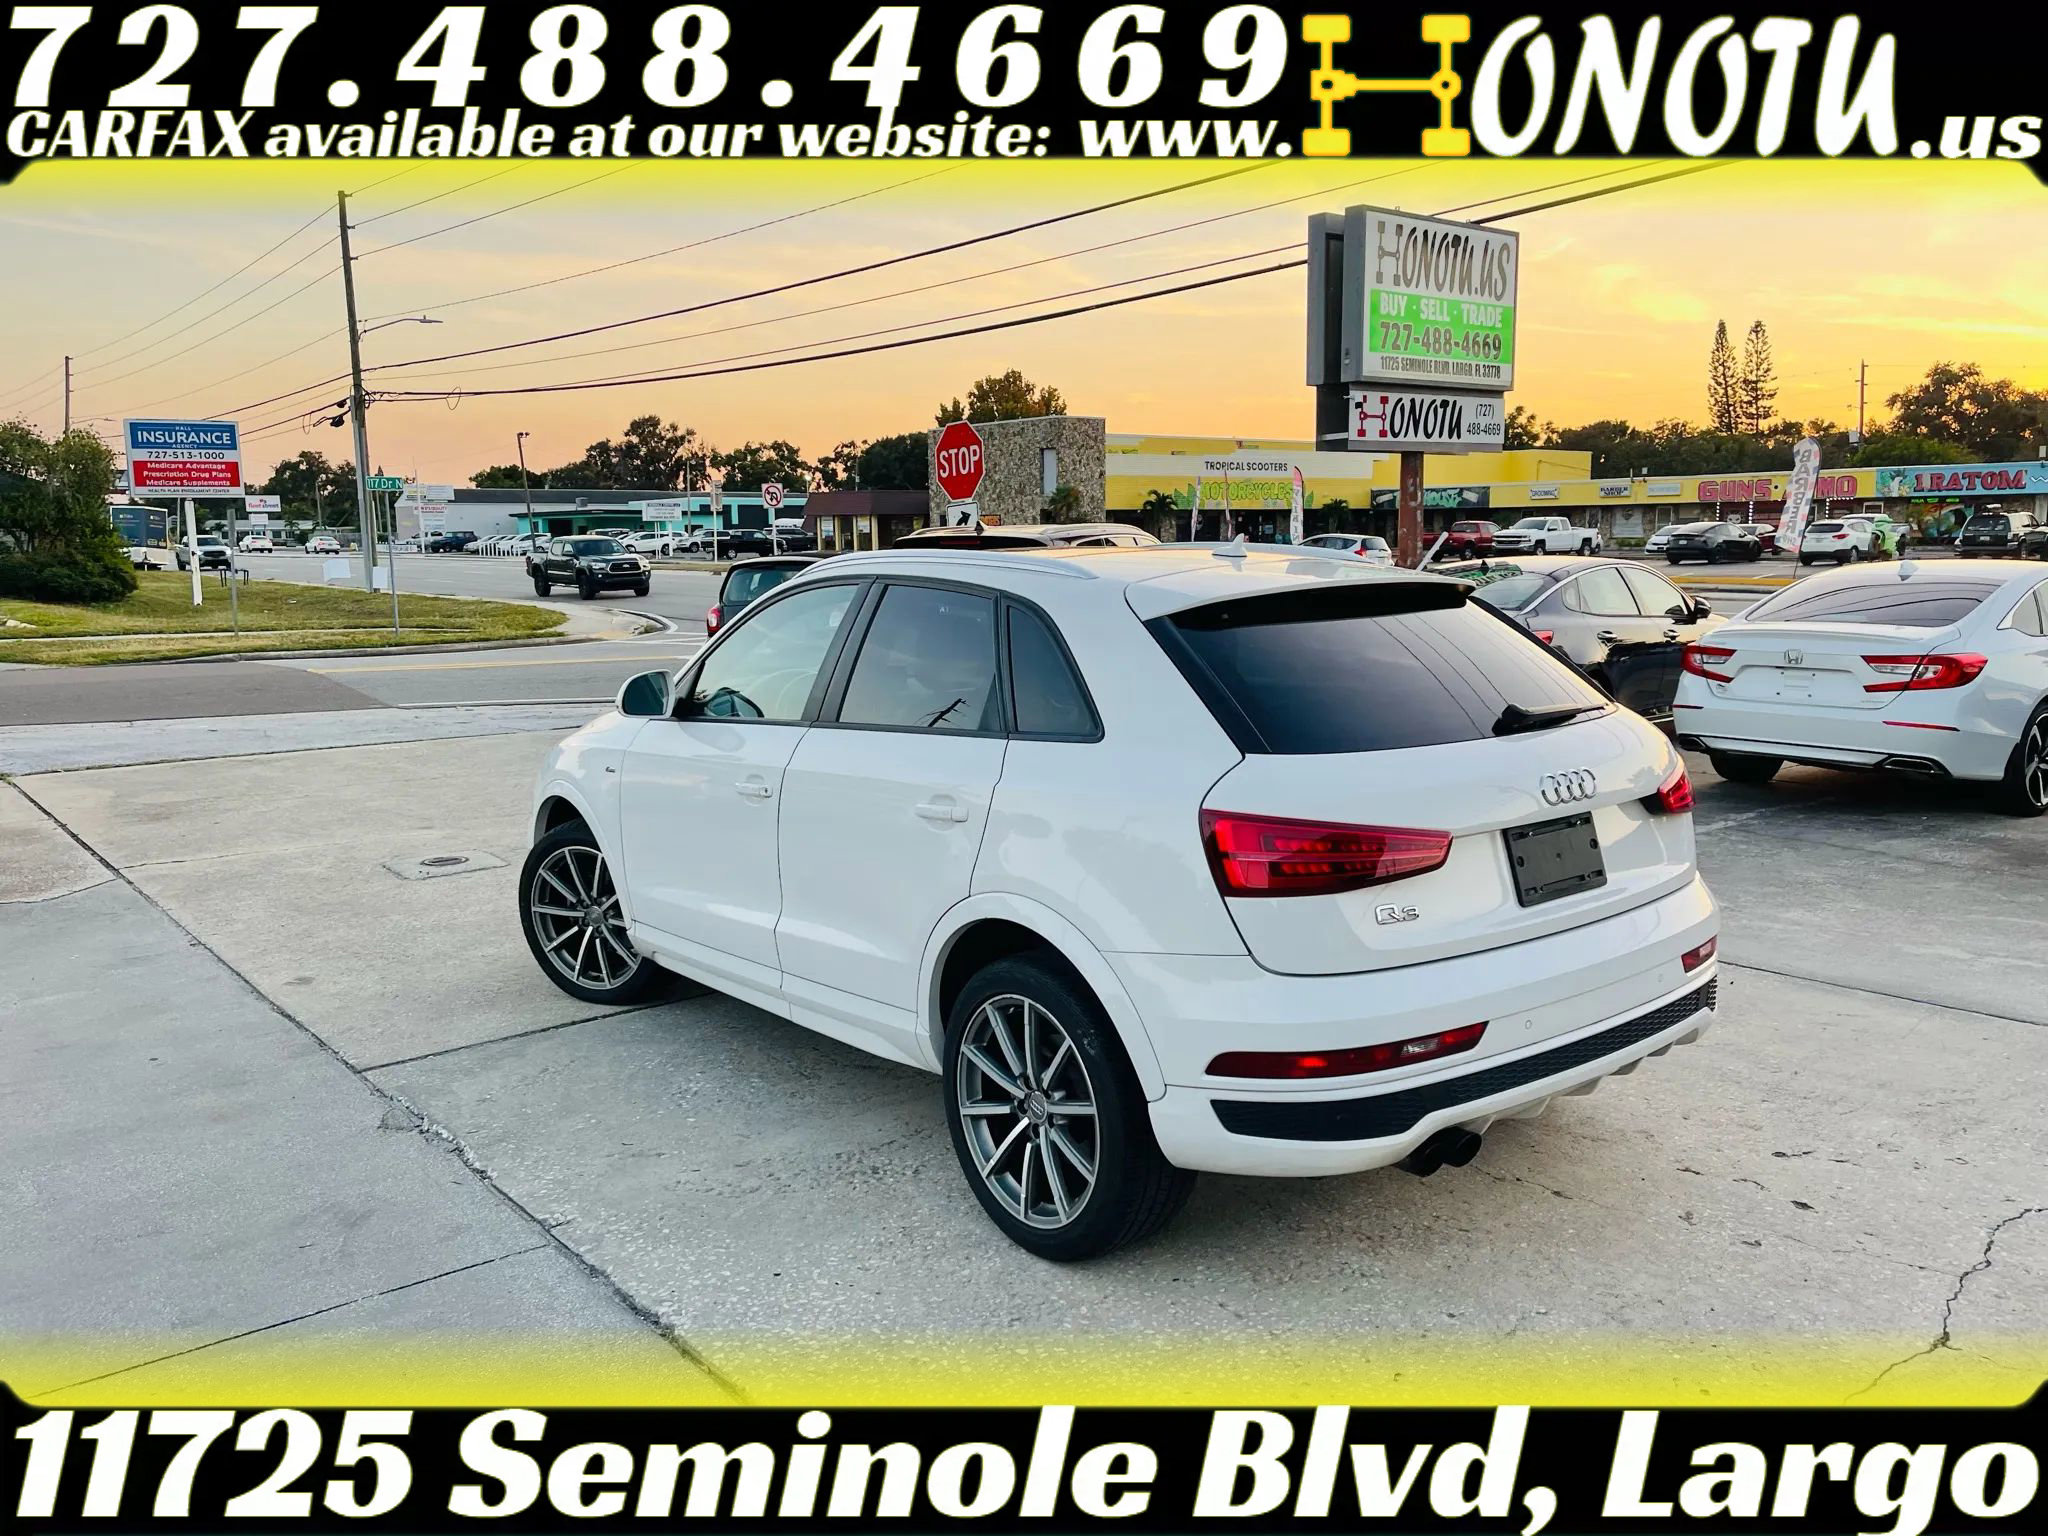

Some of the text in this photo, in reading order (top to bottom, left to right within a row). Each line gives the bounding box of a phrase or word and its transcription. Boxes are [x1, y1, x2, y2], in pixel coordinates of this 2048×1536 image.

[1380, 292, 1503, 329] BUY SELL TRADE
[1380, 321, 1502, 361] 727-488-4669
[1380, 355, 1400, 371] 11725
[1400, 357, 1433, 375] SEMINOLE
[1482, 364, 1501, 380] 33778
[1475, 403, 1495, 420] (727)
[1466, 422, 1501, 436] 488-4669
[137, 430, 232, 445] INSURANCE
[147, 450, 225, 460] 727-513-1000
[939, 444, 981, 478] STOP
[185, 462, 226, 470] Advantage
[1205, 460, 1288, 472] TROPICAL SCOOTERS
[143, 470, 190, 478] Prescription
[191, 471, 210, 479] Drug
[183, 479, 231, 487] Supplements
[381, 478, 393, 489] Dr
[1698, 479, 1772, 502] GUNS
[1375, 903, 1420, 926] Q3
